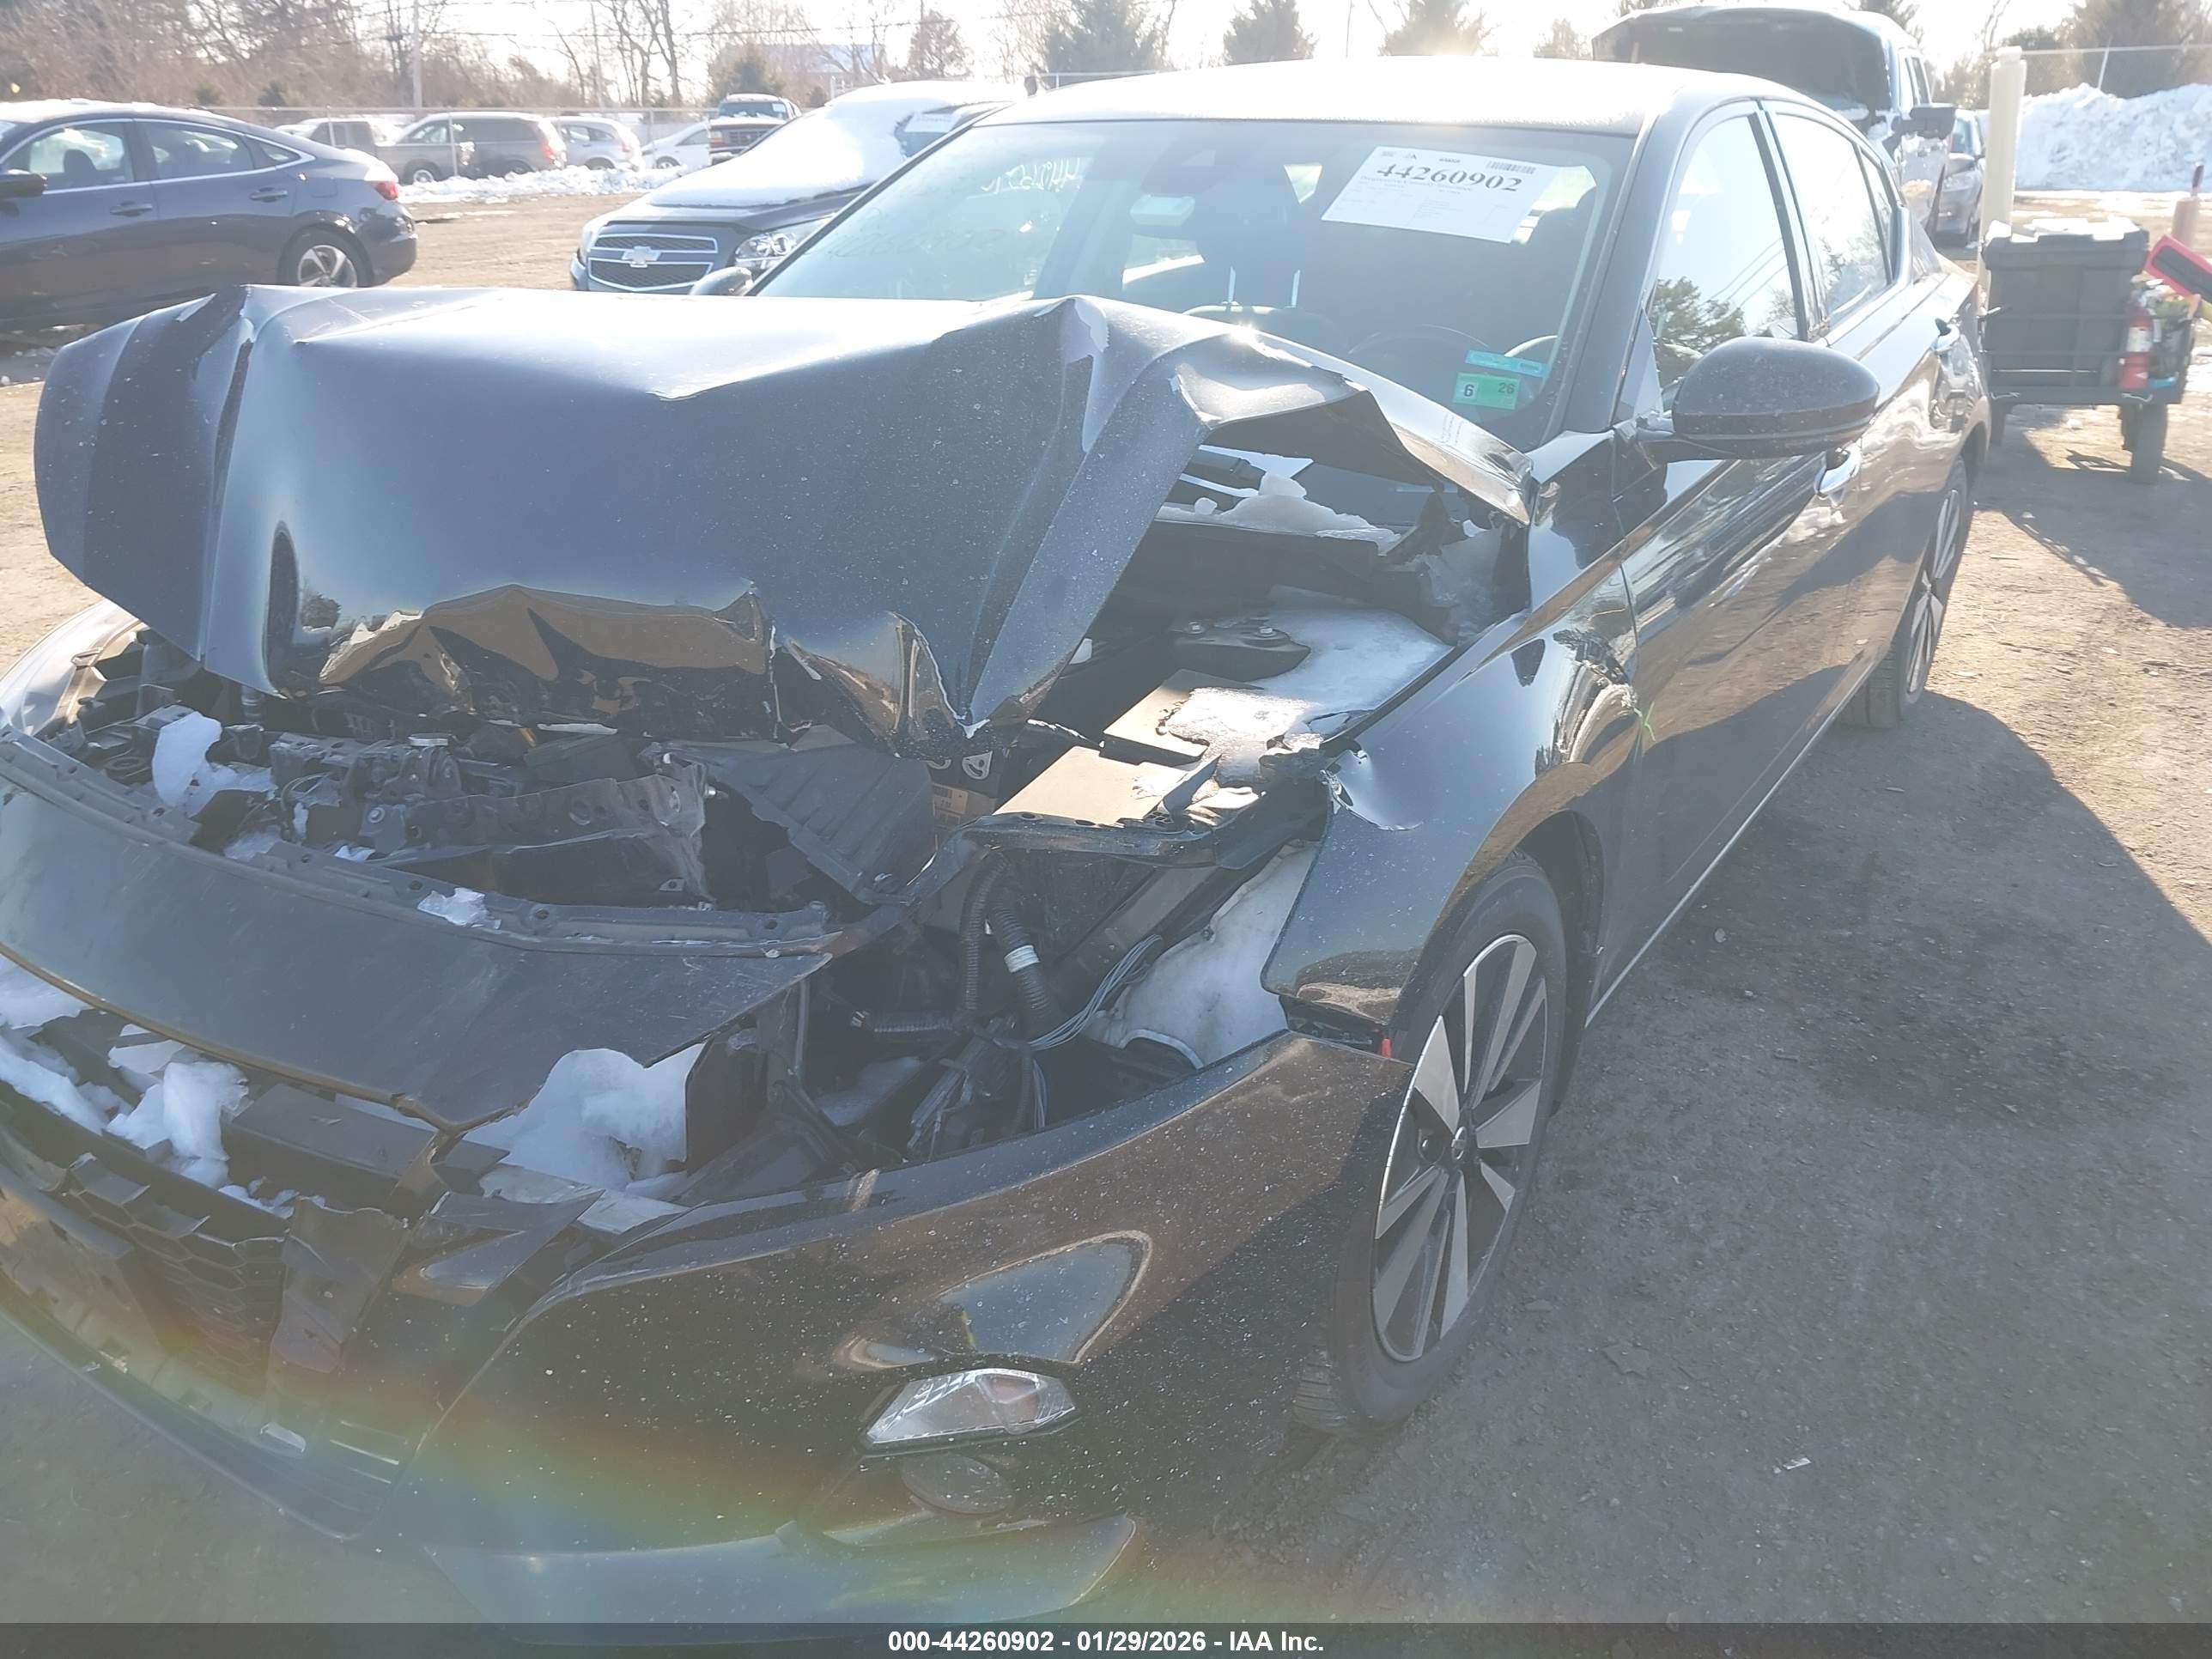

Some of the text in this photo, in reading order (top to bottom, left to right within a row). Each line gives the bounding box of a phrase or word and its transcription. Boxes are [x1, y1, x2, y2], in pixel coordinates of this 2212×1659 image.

[1376, 163, 1522, 191] 44260902
[1464, 382, 1516, 397] 6 26
